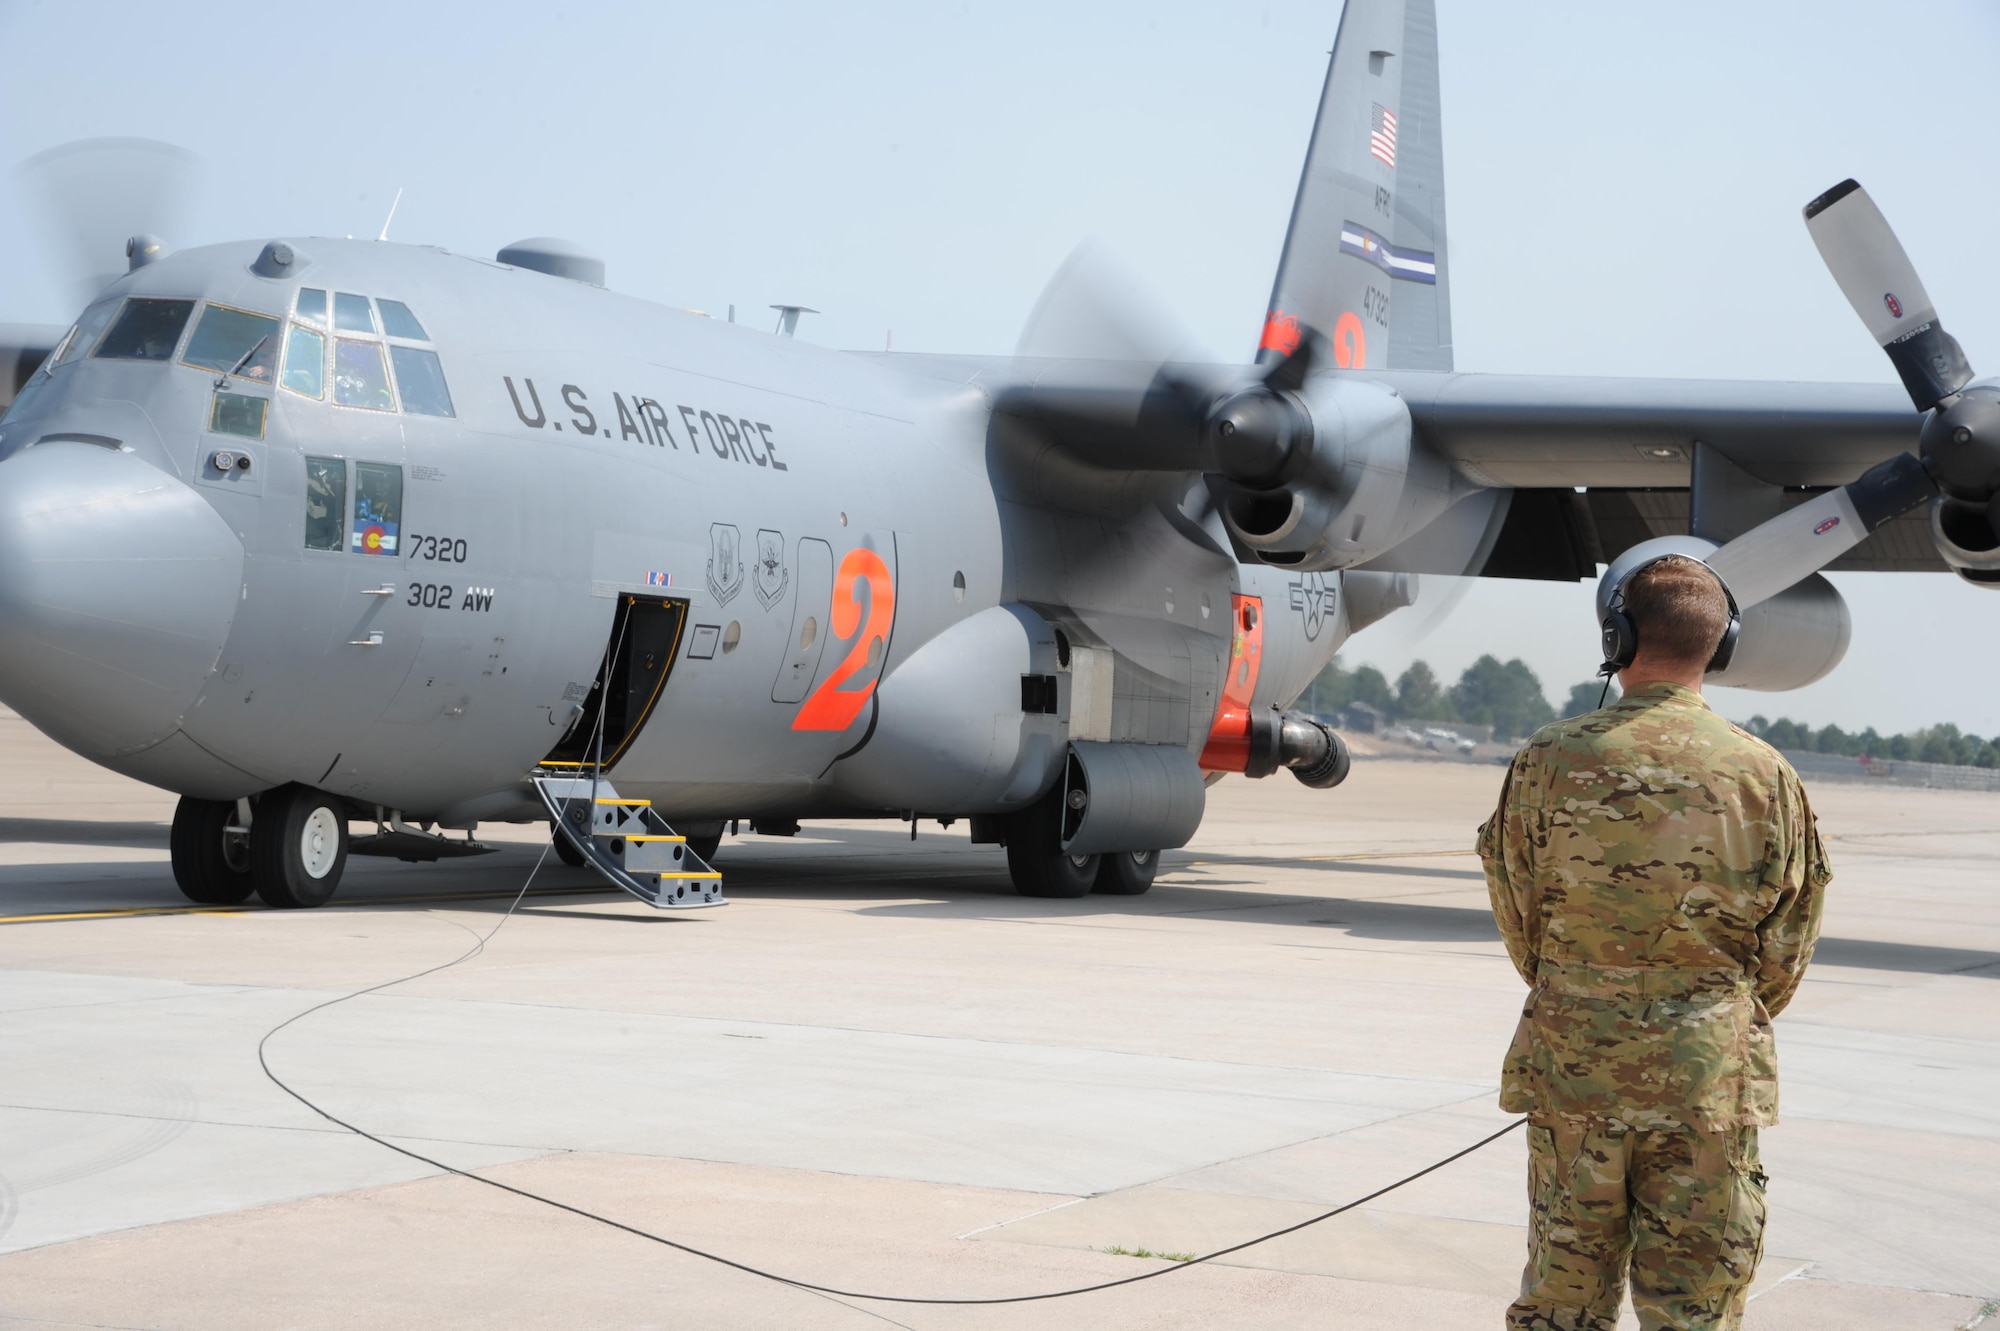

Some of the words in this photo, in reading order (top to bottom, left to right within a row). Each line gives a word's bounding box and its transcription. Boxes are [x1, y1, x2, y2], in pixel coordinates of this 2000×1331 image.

[1374, 184, 1391, 219] AFRC
[1363, 284, 1389, 329] 47320
[503, 376, 611, 438] U.S.
[612, 391, 679, 450] AIR
[677, 404, 788, 471] FORCE
[409, 534, 467, 563] 7320
[407, 582, 453, 609] 302
[461, 586, 495, 612] AW
[791, 548, 894, 731] 2
